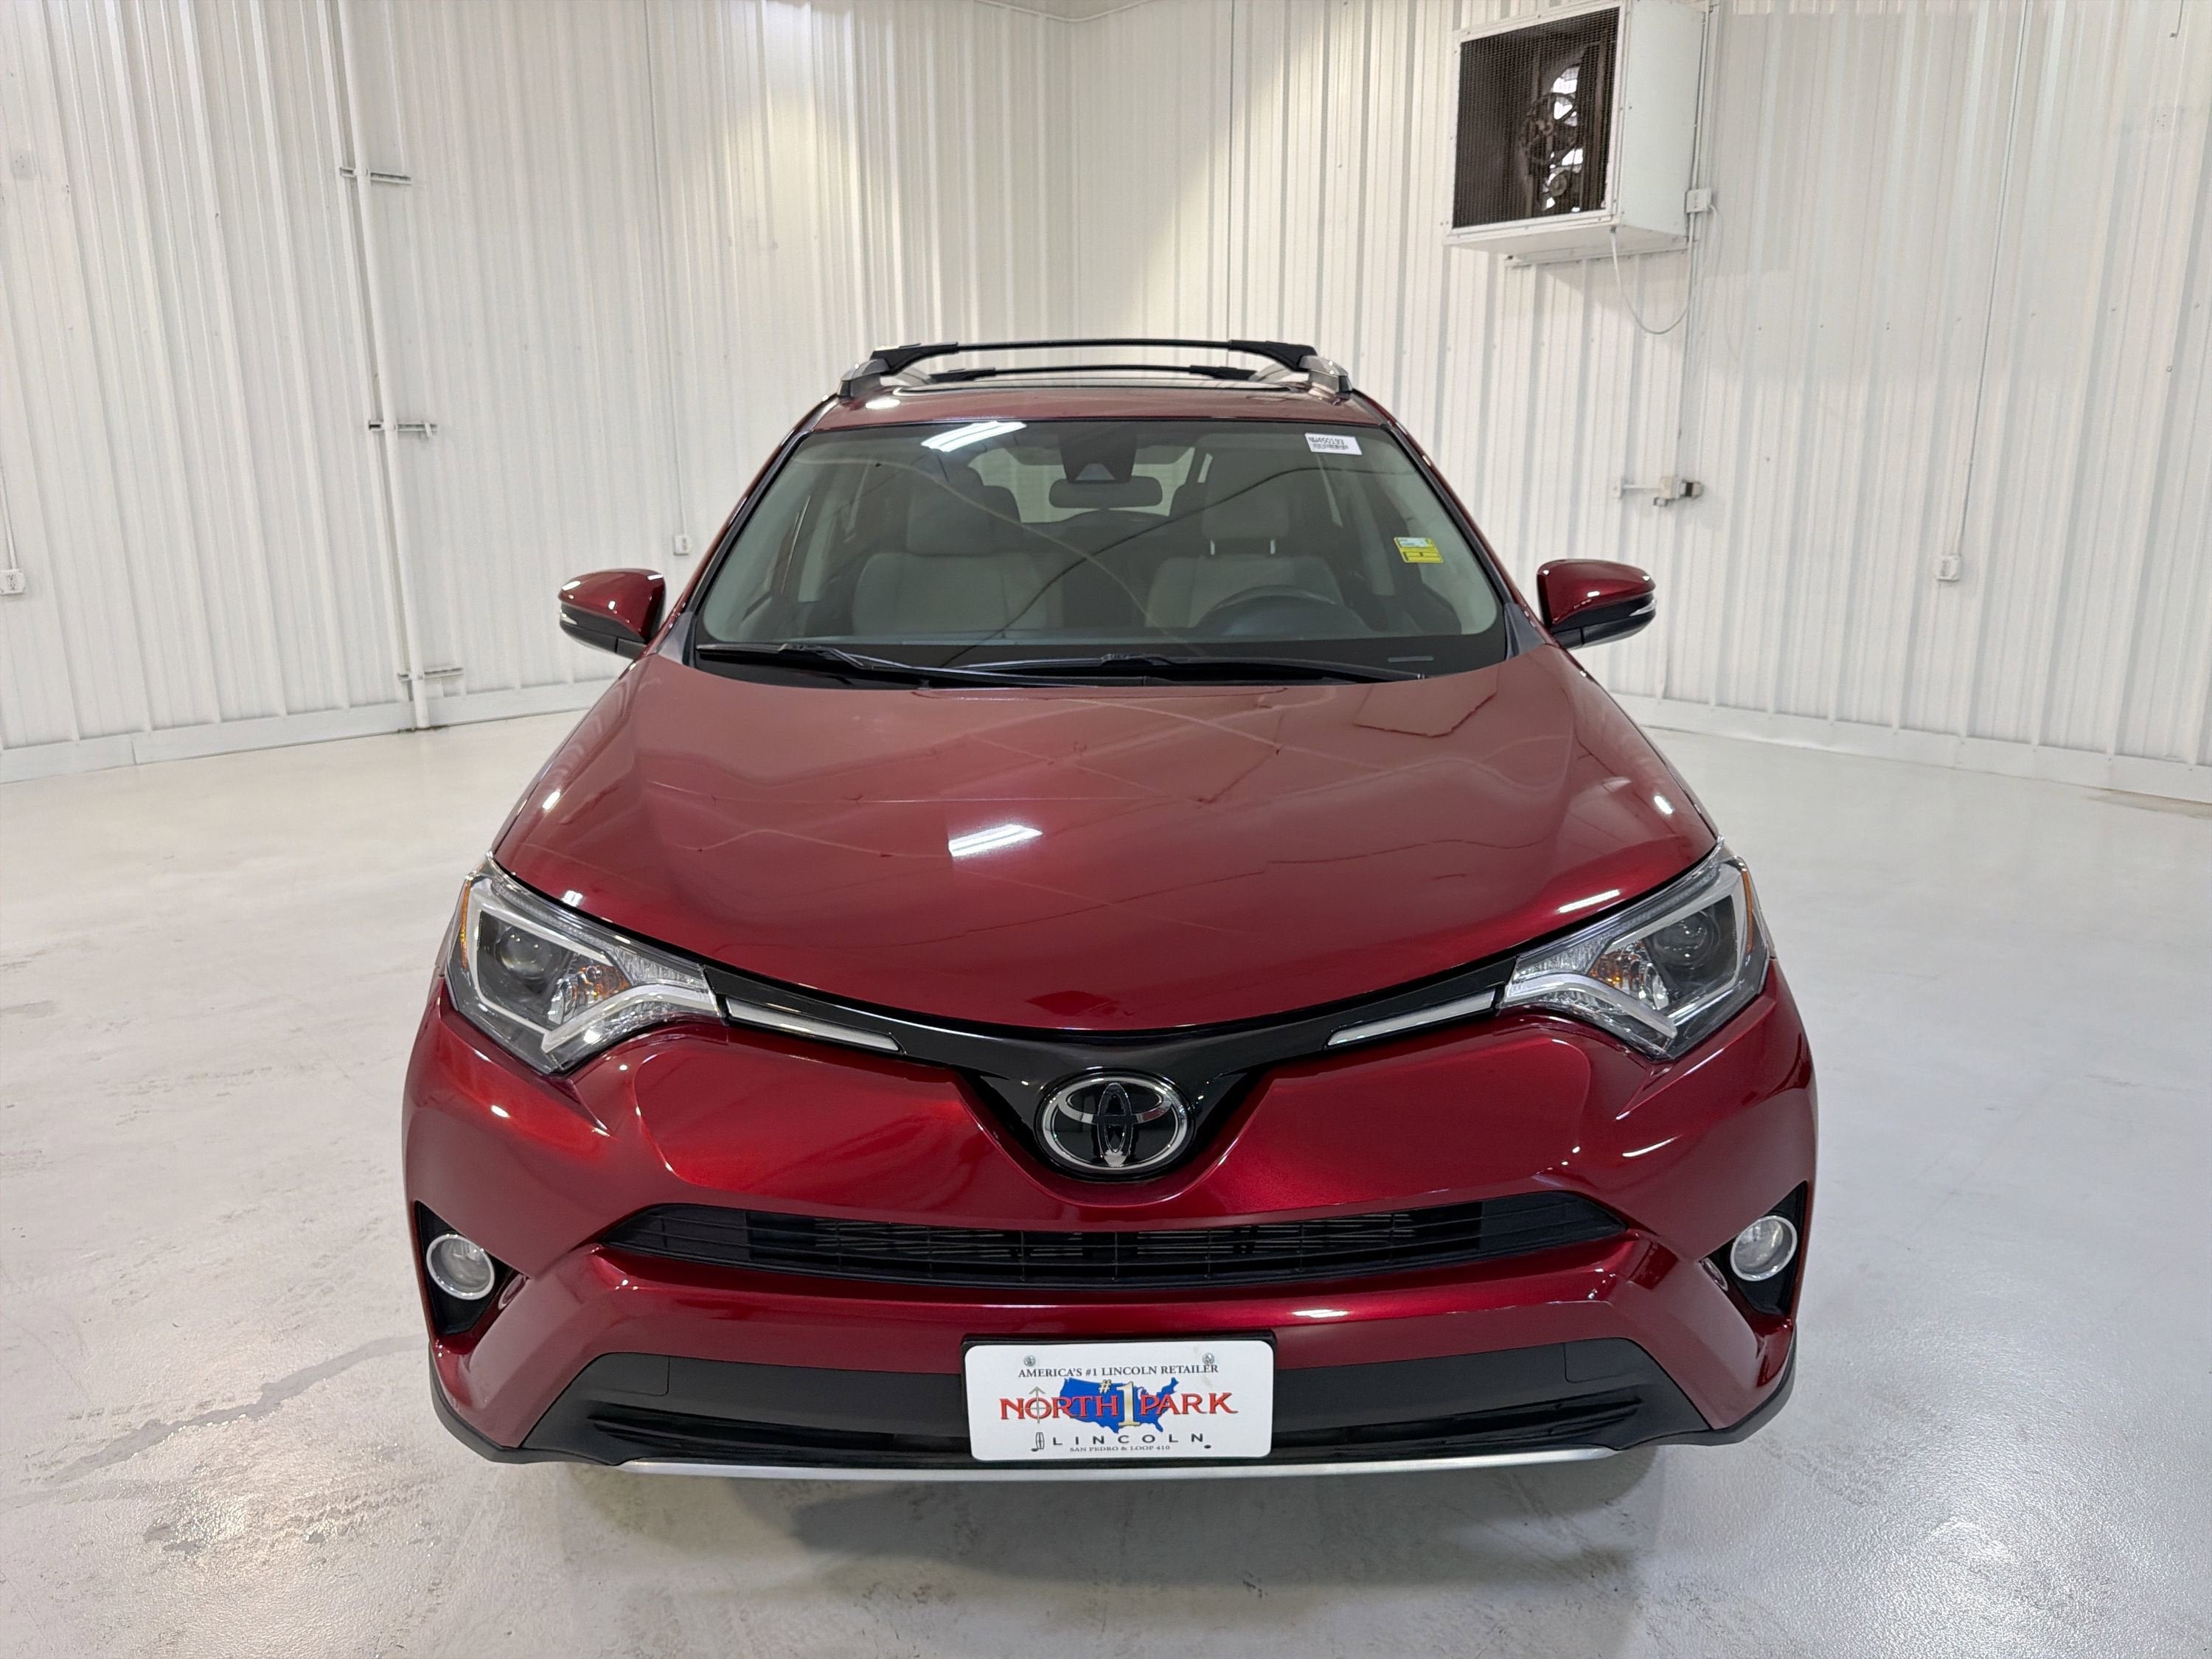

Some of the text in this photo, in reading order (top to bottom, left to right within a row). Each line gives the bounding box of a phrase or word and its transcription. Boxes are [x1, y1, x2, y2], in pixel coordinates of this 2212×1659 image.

[1018, 1364, 1219, 1378] AMERICA'S #1 LINCOLN RETAILER
[999, 1392, 1239, 1420] NORTH PARK
[1053, 1433, 1203, 1446] LINCOLN
